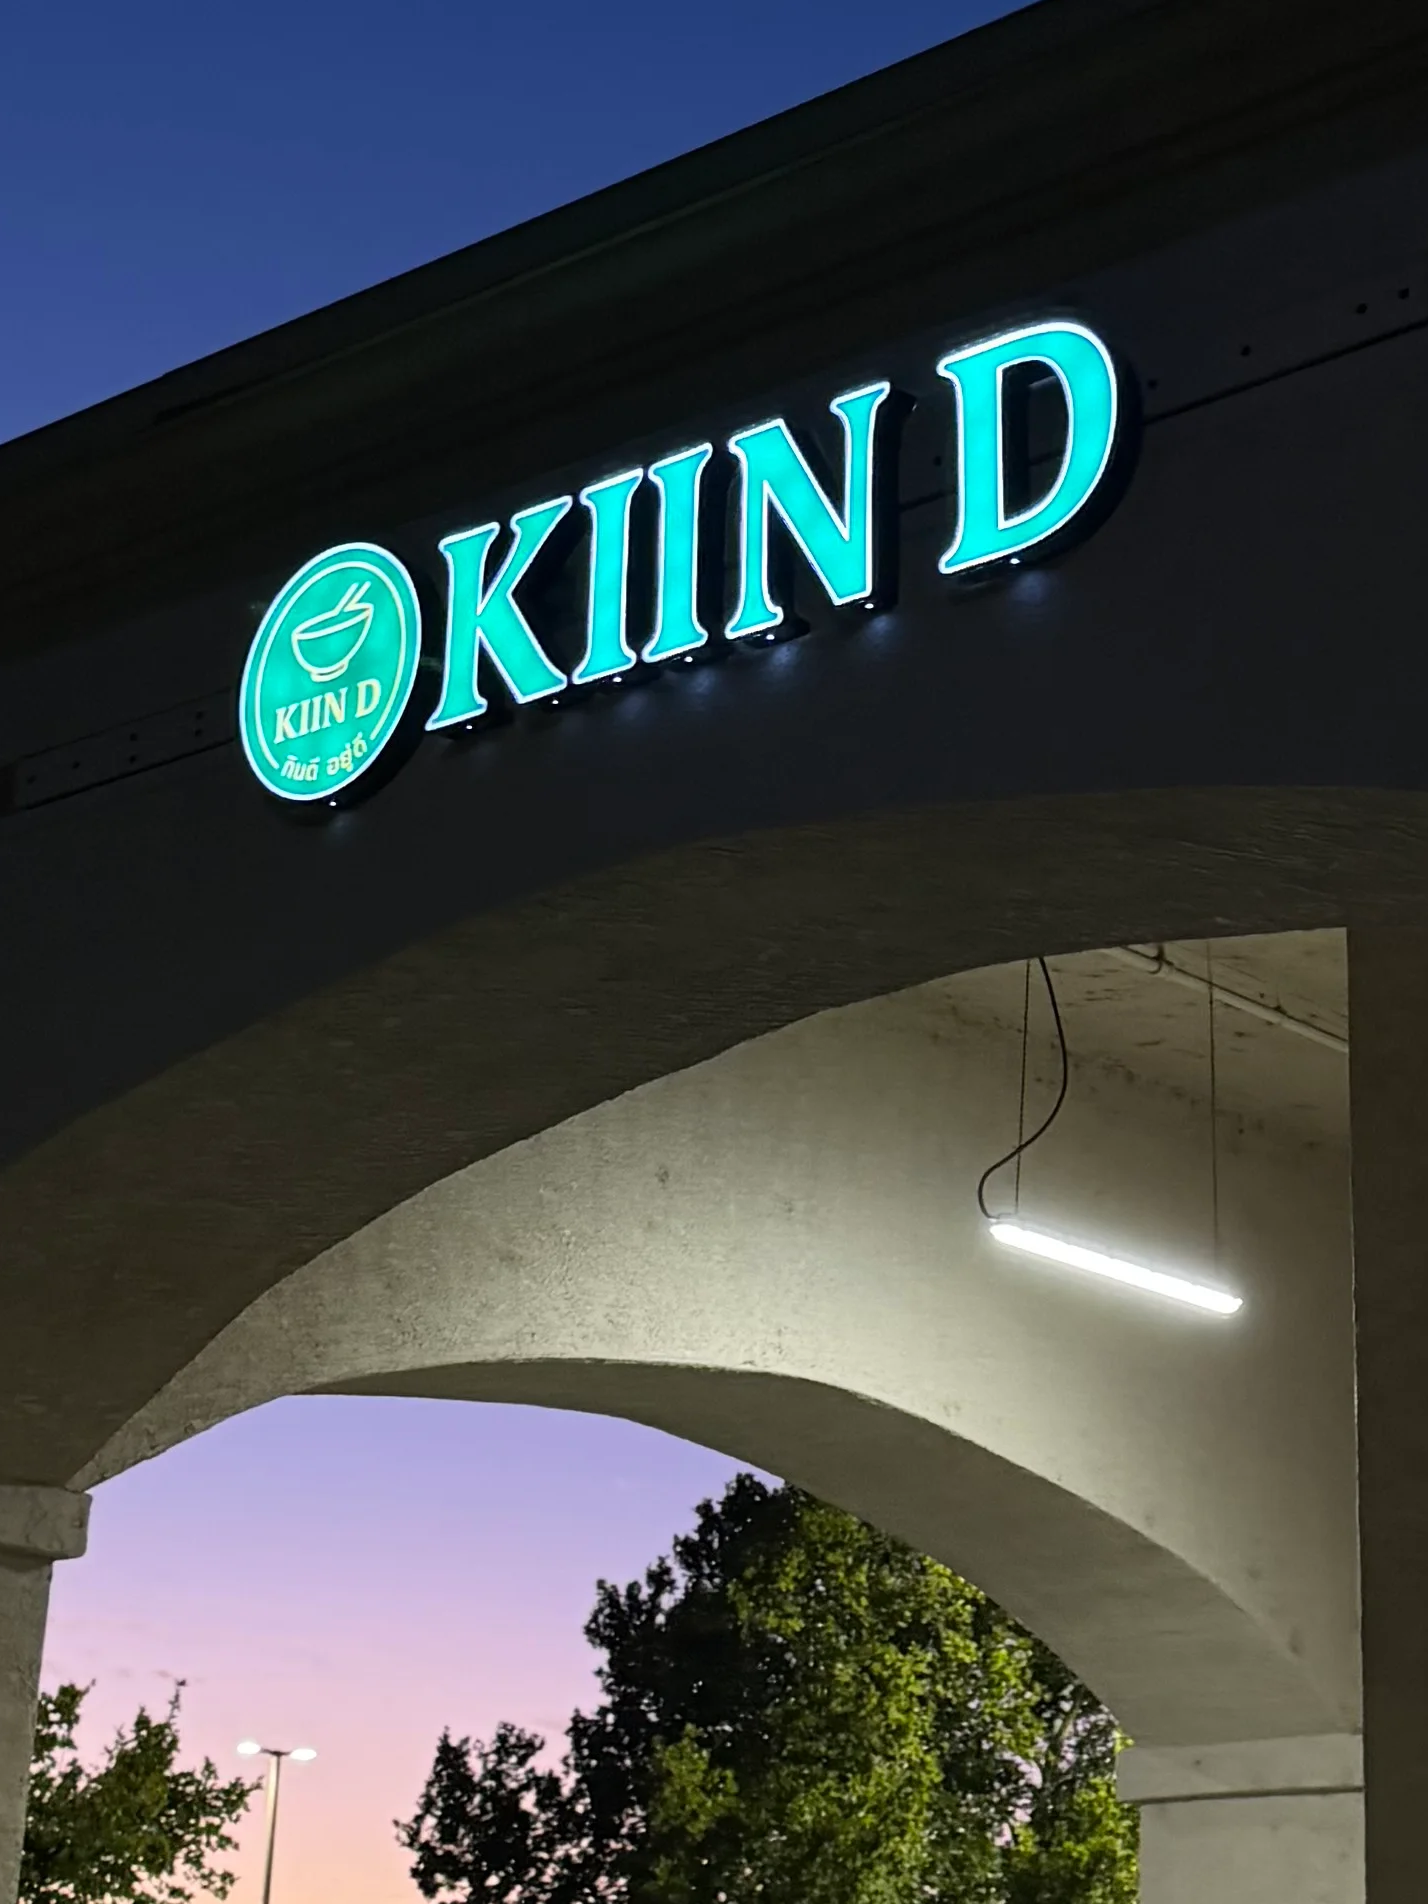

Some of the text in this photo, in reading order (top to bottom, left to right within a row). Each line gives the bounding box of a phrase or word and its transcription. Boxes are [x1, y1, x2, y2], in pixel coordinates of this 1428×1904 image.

[426, 320, 1118, 731] KIIN D
[274, 678, 382, 744] KIIN D
